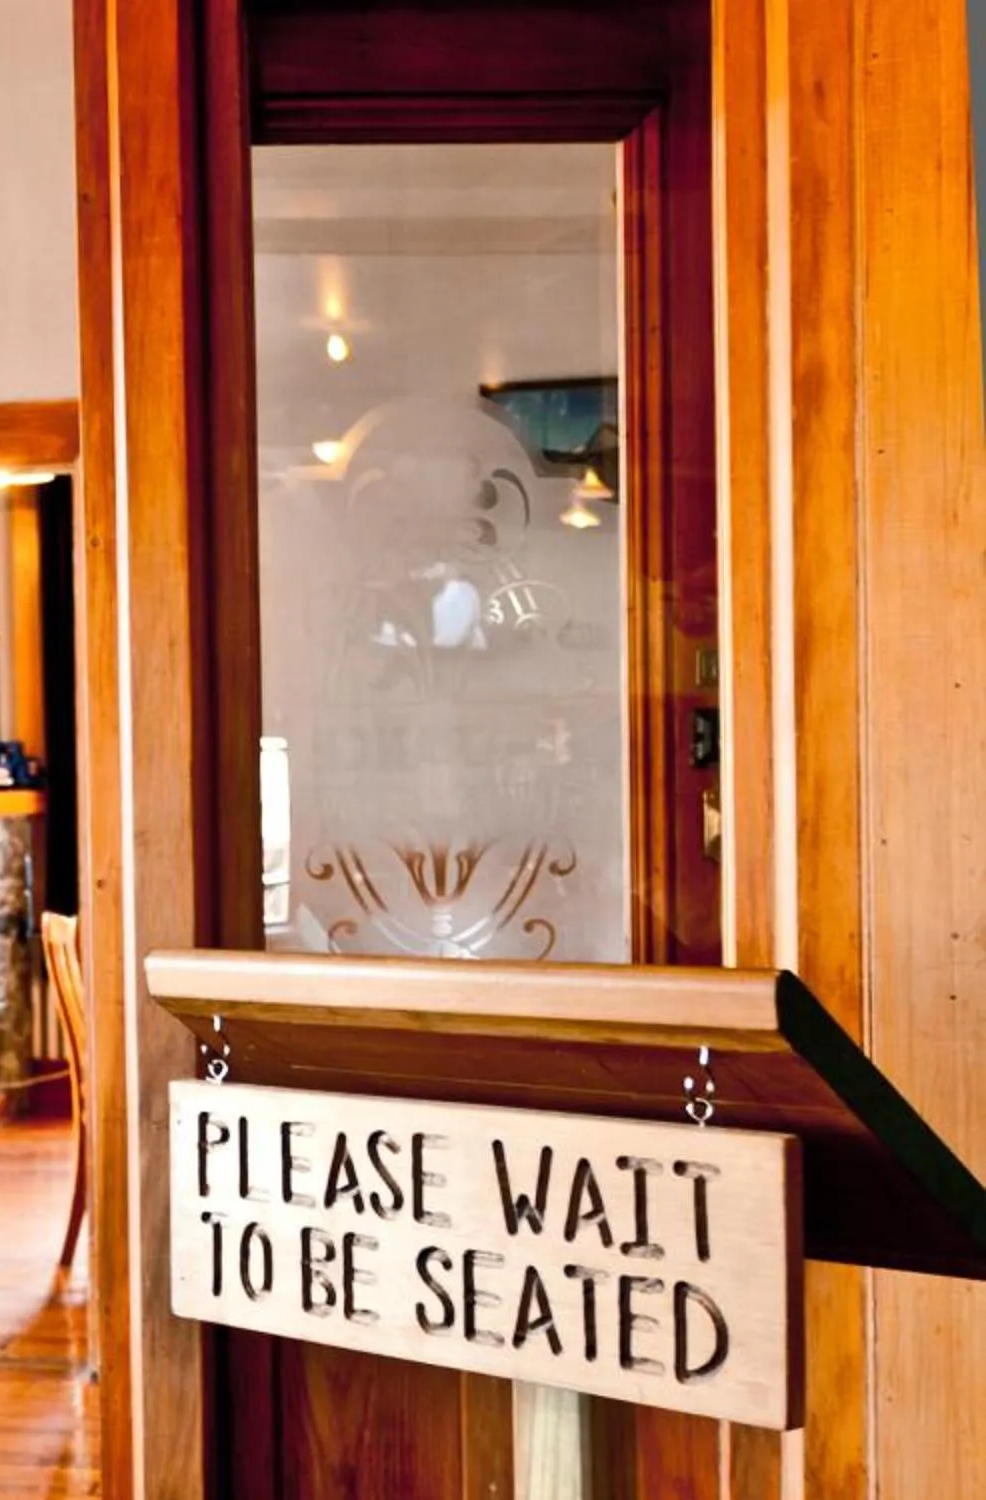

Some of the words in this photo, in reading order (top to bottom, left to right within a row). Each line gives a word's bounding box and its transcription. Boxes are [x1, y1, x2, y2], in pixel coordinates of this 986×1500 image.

[197, 1110, 453, 1228] PLEASE
[491, 1139, 720, 1261] WAIT
[201, 1211, 274, 1302] TO
[300, 1227, 381, 1324] BE
[415, 1246, 730, 1383] SEATED
